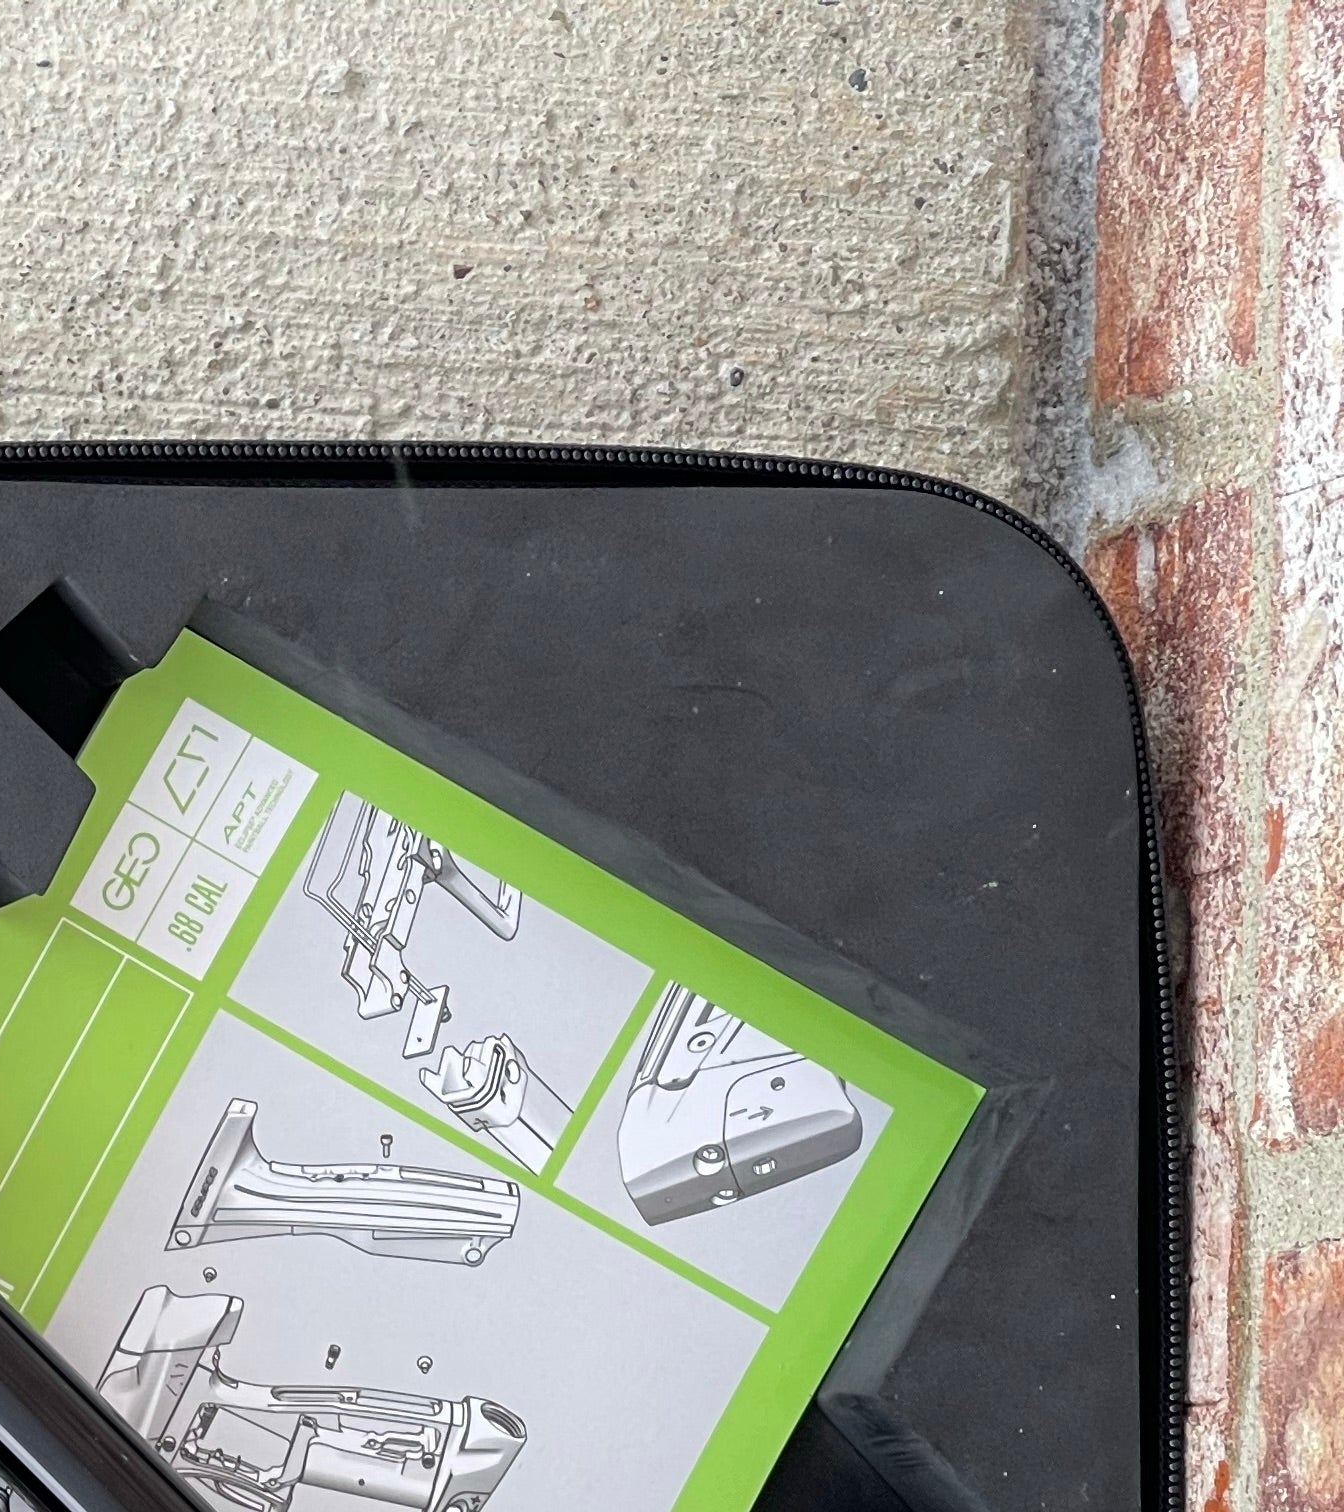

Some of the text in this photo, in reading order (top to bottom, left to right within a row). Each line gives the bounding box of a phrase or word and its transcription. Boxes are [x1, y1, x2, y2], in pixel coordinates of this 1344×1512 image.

[223, 781, 257, 845] APT
[102, 832, 161, 911] GEO
[167, 874, 229, 953] .68 CAL
